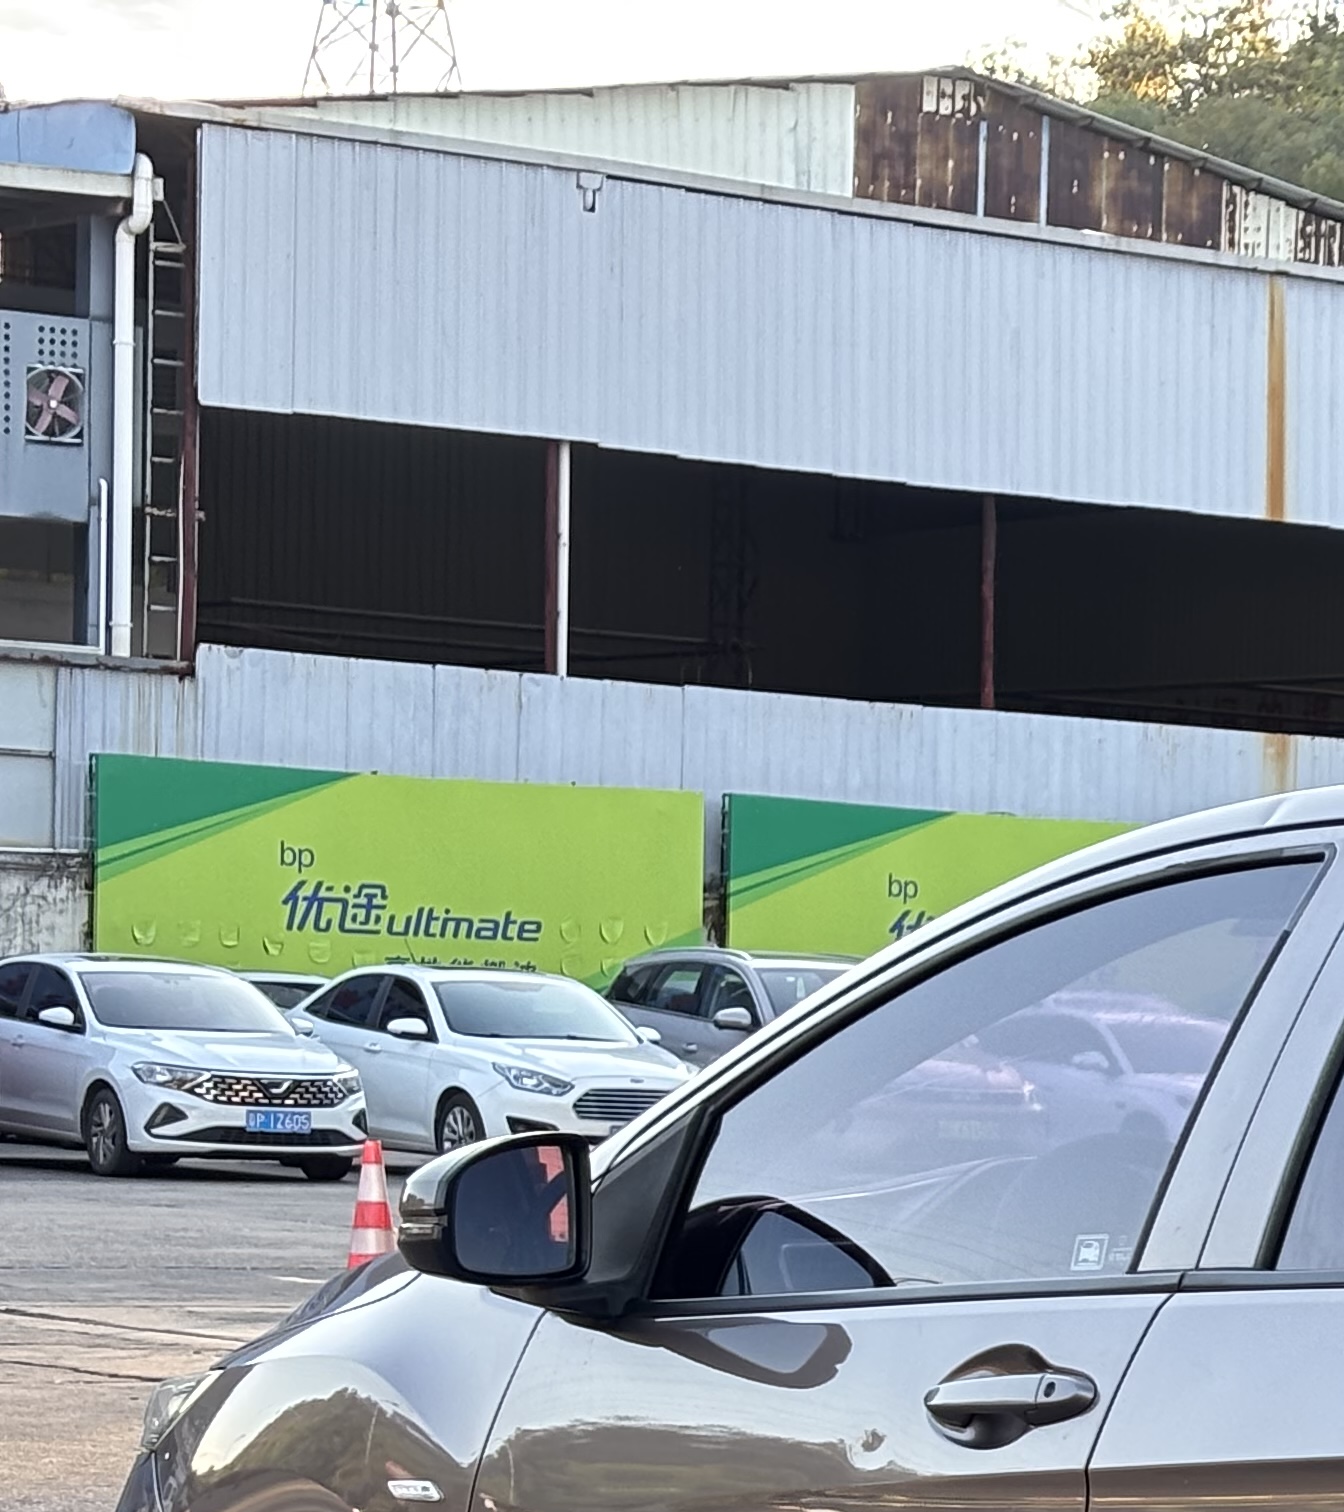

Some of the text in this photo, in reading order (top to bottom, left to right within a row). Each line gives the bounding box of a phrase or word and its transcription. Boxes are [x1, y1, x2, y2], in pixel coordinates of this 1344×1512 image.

[280, 839, 315, 874] bp
[888, 872, 918, 904] bp
[281, 879, 543, 943] 优途 ultimate
